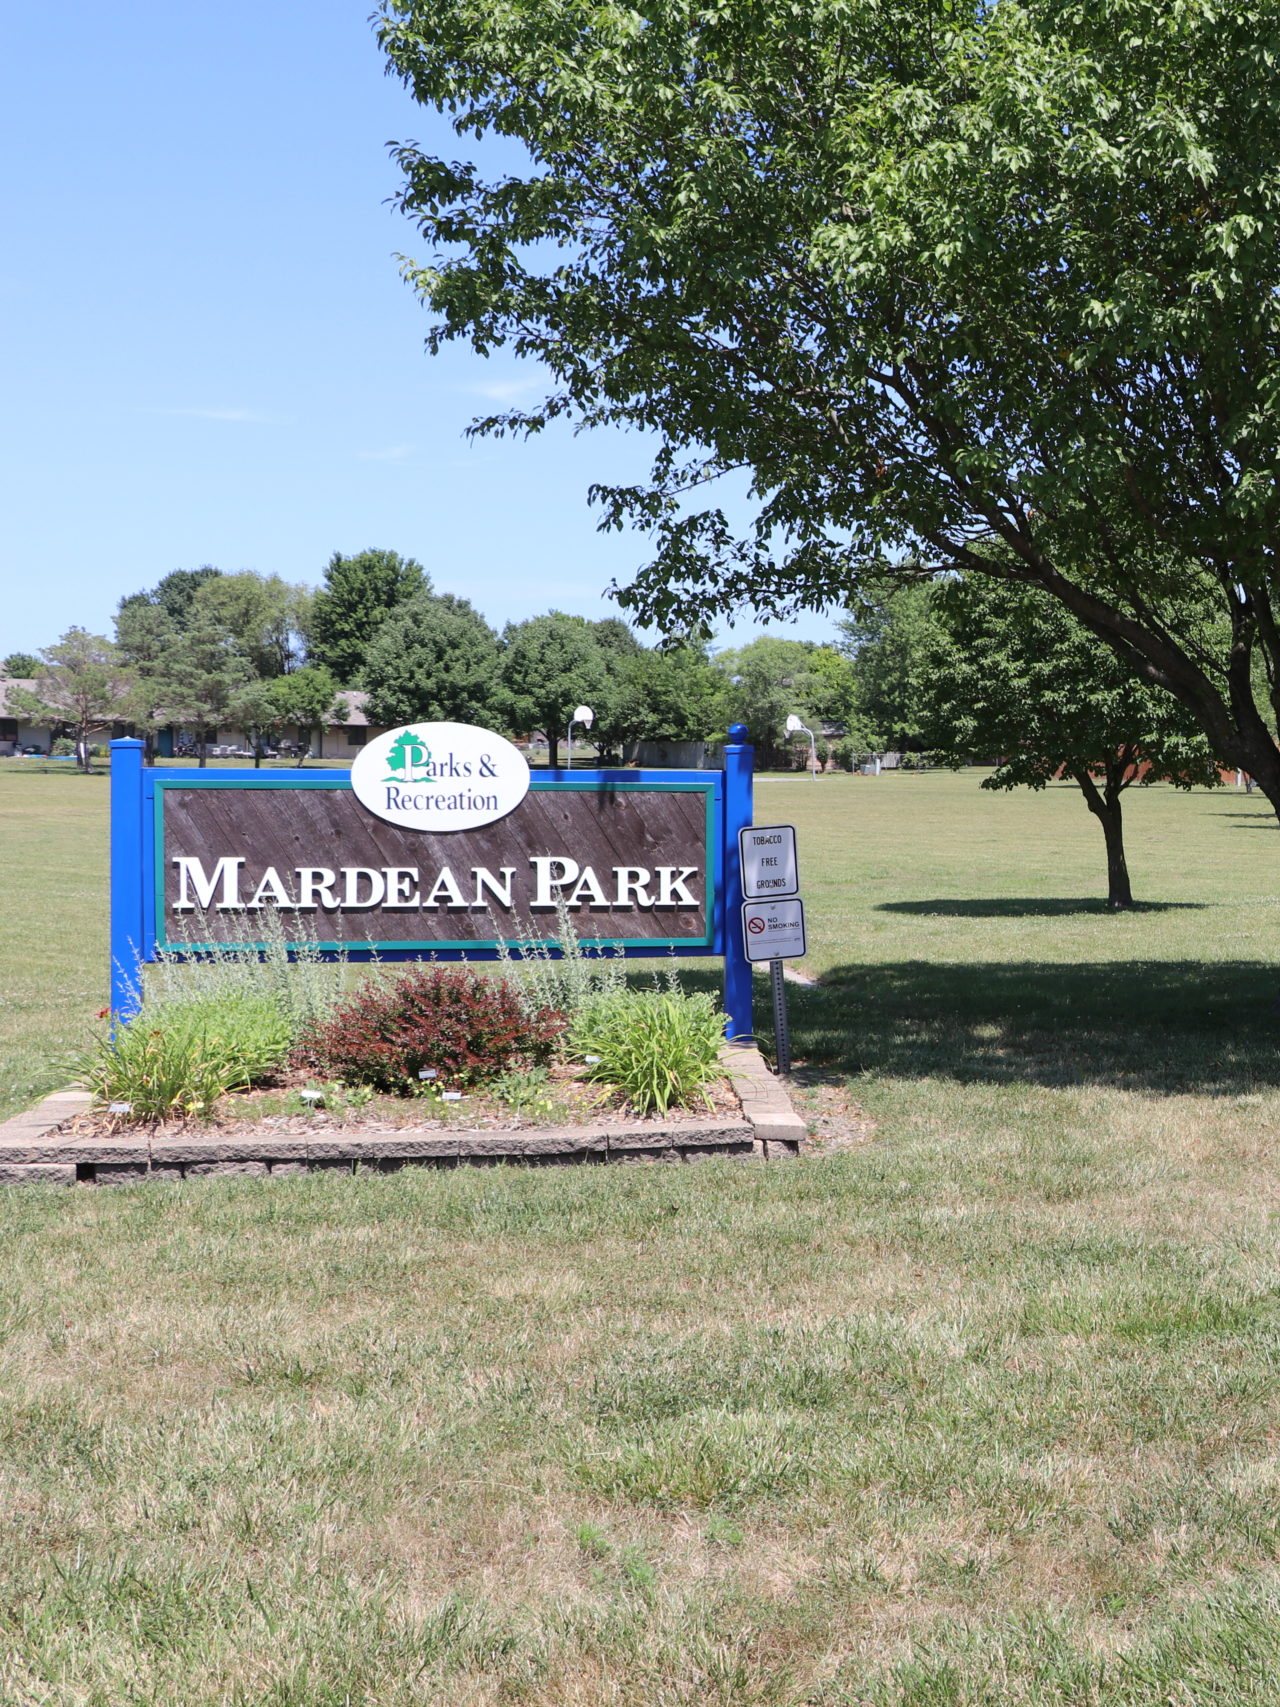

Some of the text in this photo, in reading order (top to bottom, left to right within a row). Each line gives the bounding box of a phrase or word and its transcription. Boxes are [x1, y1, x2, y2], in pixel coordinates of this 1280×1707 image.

[401, 743, 499, 783] Parks &
[385, 786, 498, 810] Recreation
[753, 834, 782, 846] TOBACCO
[761, 857, 778, 867] FREE
[529, 856, 700, 907] PARK
[756, 878, 786, 889] GROUNDS
[768, 922, 800, 930] SMOKING
